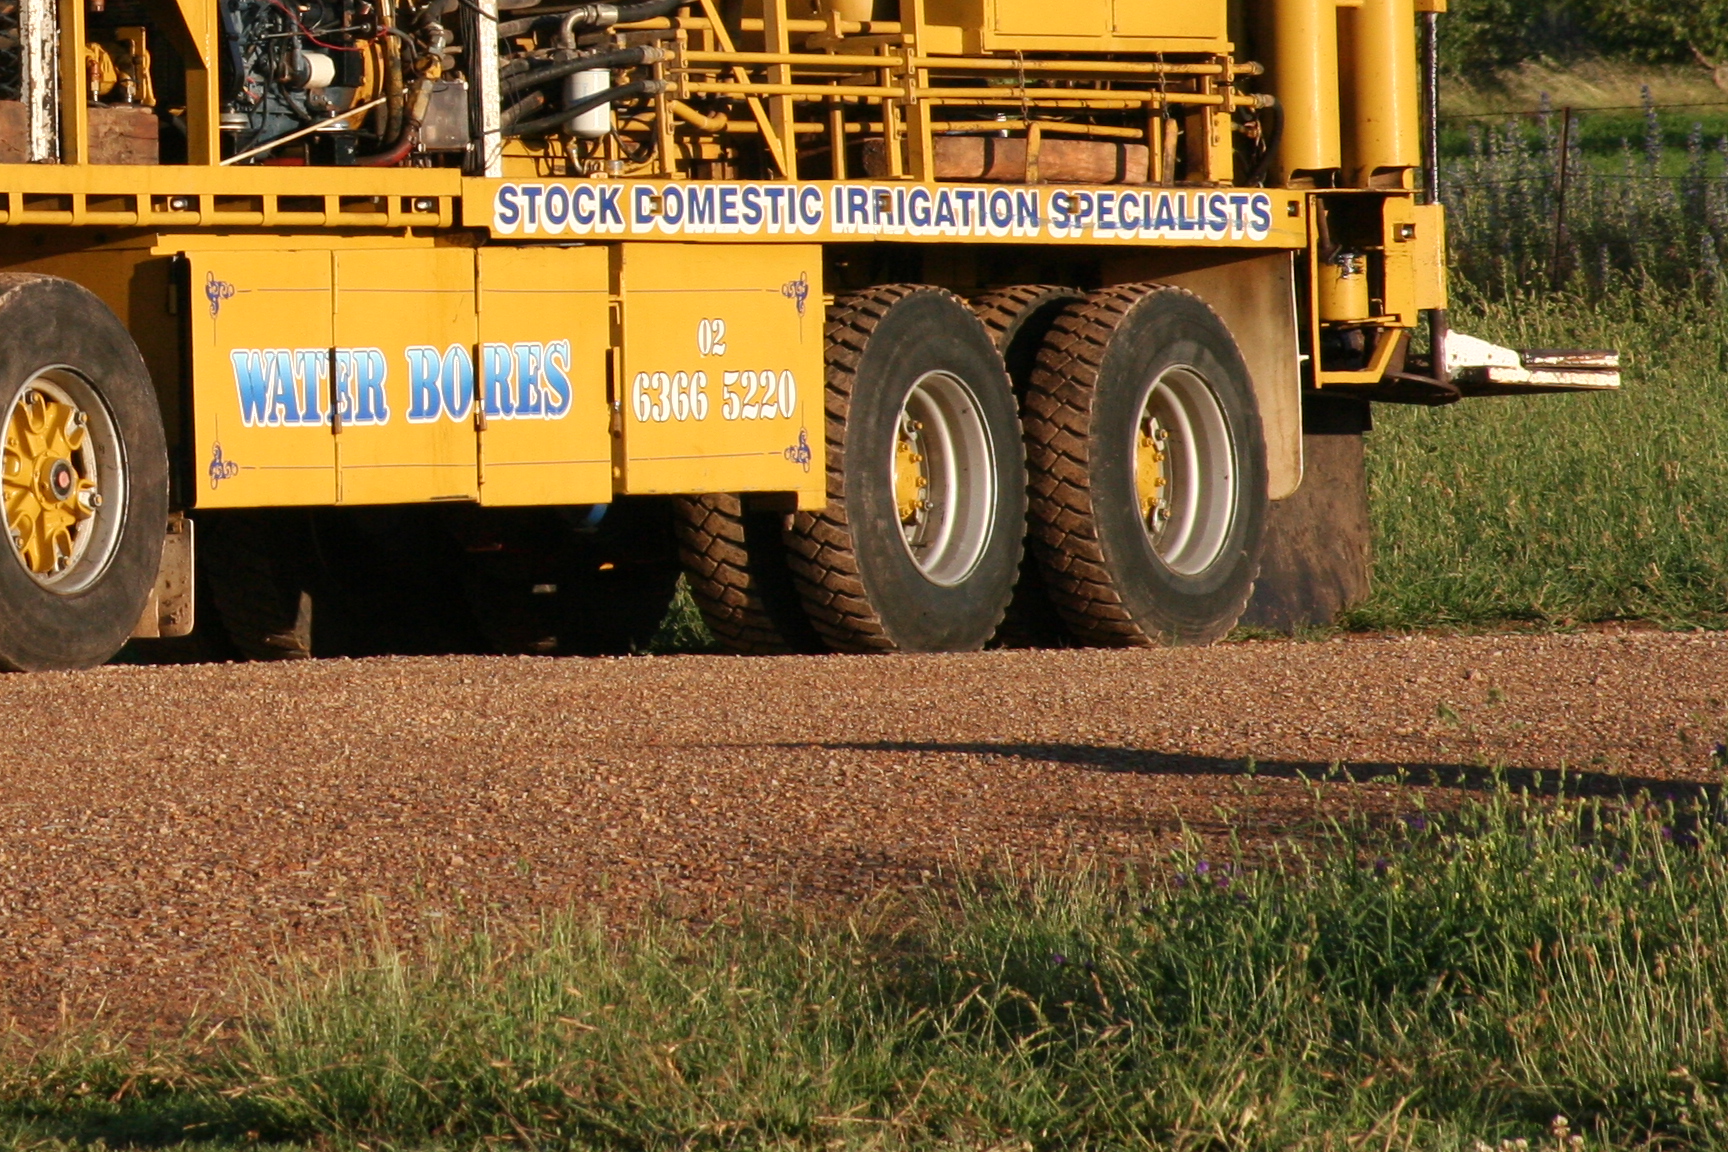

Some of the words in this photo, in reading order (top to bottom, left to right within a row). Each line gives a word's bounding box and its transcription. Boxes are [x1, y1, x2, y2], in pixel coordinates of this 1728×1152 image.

[496, 185, 624, 229] STOCK
[633, 185, 823, 229] DOMESTIC
[834, 186, 1040, 230] IRRIGATION
[1051, 190, 1271, 233] SPECIALISTS
[697, 318, 726, 356] 02
[230, 347, 390, 426] WATER
[405, 339, 573, 424] BORES
[632, 370, 709, 422] 6366
[722, 369, 797, 421] 5220
